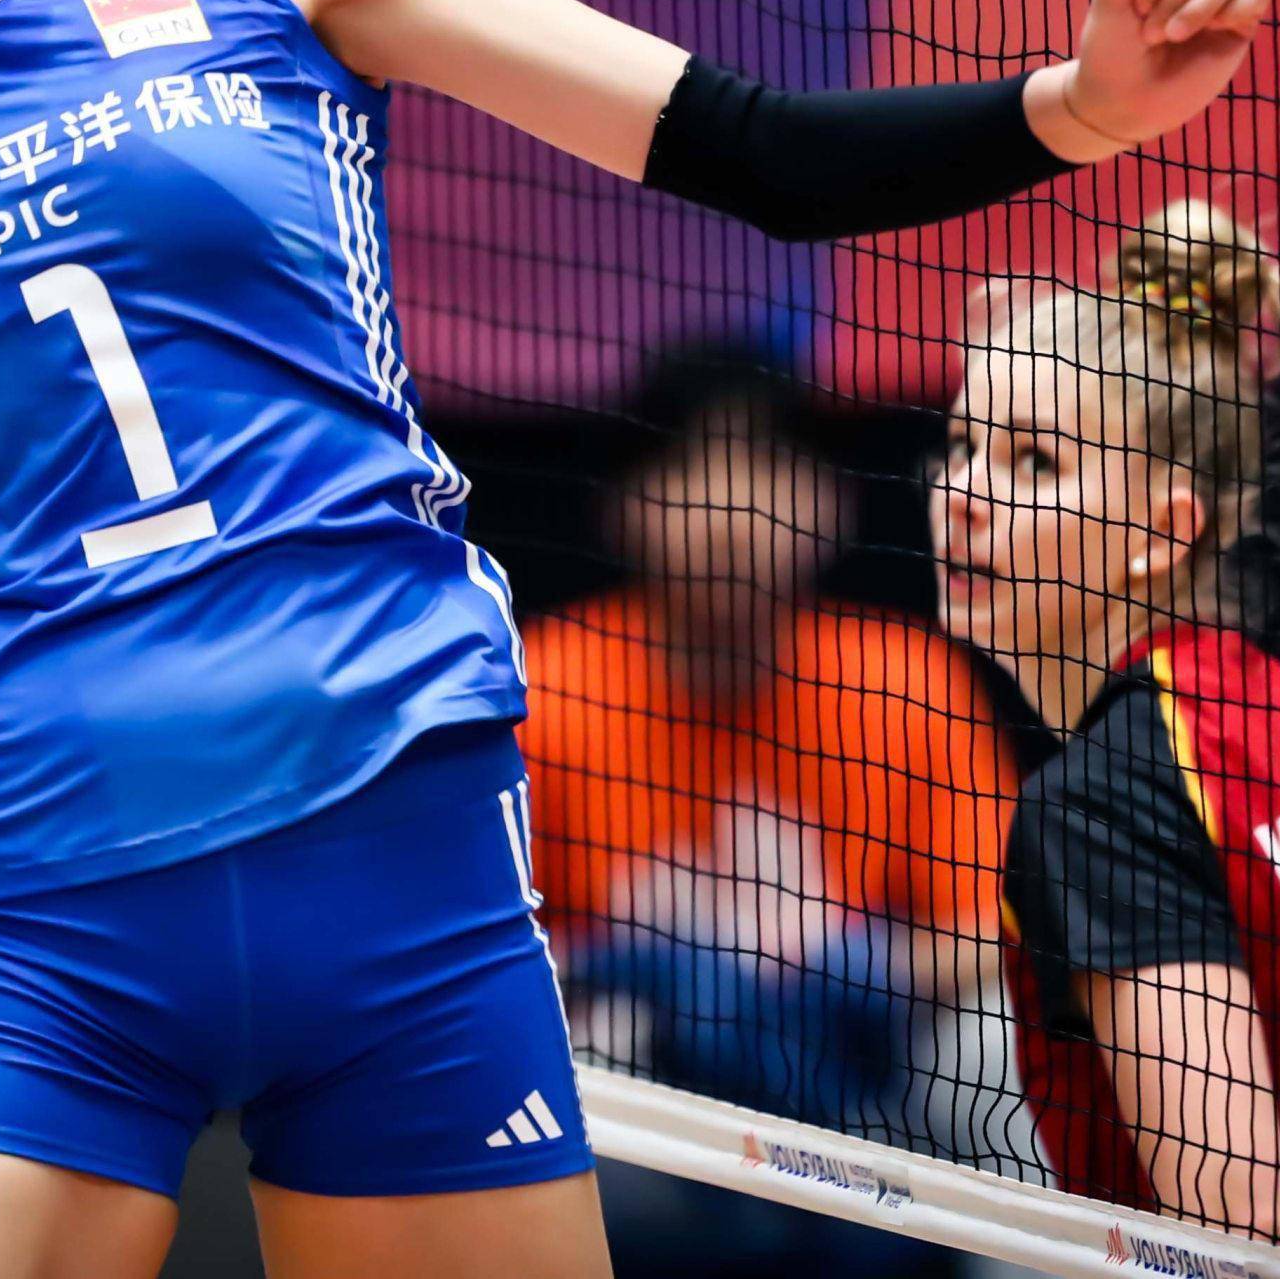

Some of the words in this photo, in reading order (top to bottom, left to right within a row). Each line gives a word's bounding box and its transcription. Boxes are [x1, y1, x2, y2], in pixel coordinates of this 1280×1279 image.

[118, 17, 194, 45] CHN
[20, 263, 218, 569] 1
[764, 1141, 850, 1189] VOLLEYBALL
[1130, 1236, 1218, 1279] VOLLEYBALL
